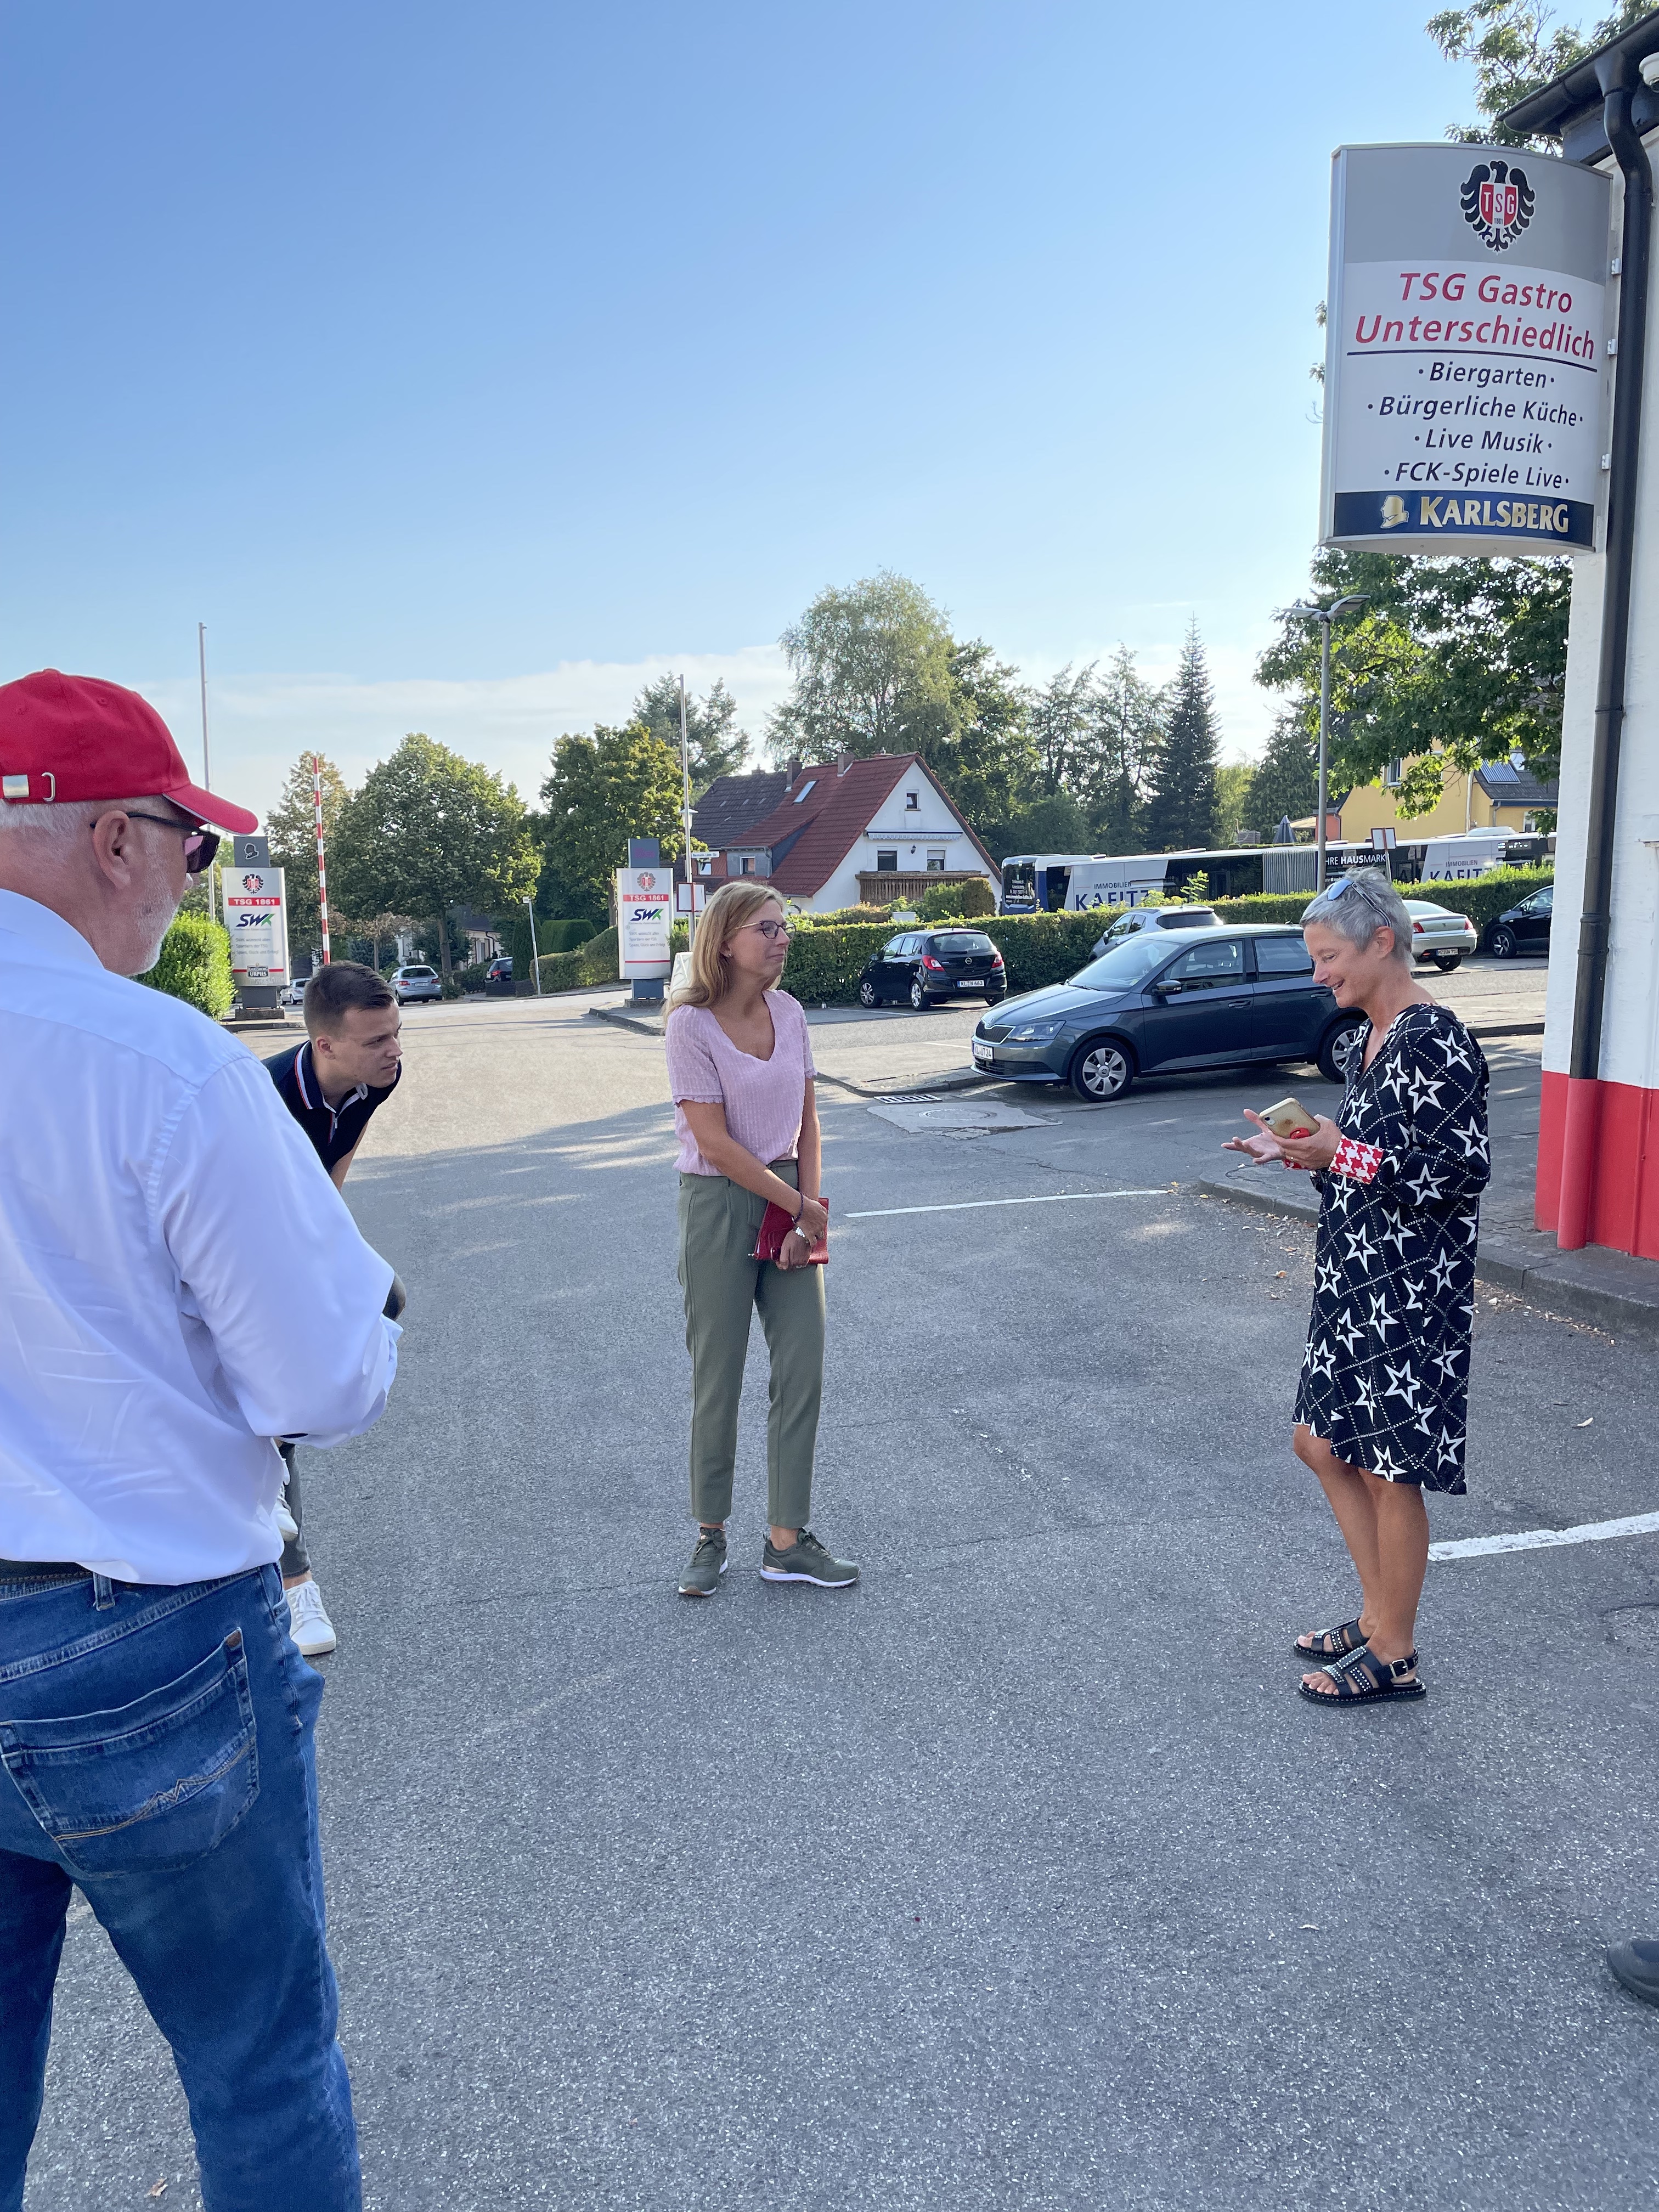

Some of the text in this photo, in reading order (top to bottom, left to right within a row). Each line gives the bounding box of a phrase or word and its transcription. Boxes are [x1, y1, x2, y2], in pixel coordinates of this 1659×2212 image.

[1483, 191, 1515, 215] TSG
[1400, 272, 1572, 313] TSG Gastro
[1356, 314, 1594, 360] Unterschiedlich
[1429, 361, 1547, 388] Biergarten
[1379, 394, 1577, 427] Bürgerliche Küche
[1425, 428, 1544, 454] Live Musik
[1395, 462, 1562, 489] FCK-Spiele Live
[1419, 496, 1569, 533] KARLSBERG
[1340, 854, 1386, 865] HAUSMARK
[1430, 867, 1492, 882] KAFIT
[235, 913, 276, 927] SWK
[630, 908, 664, 922] SWK
